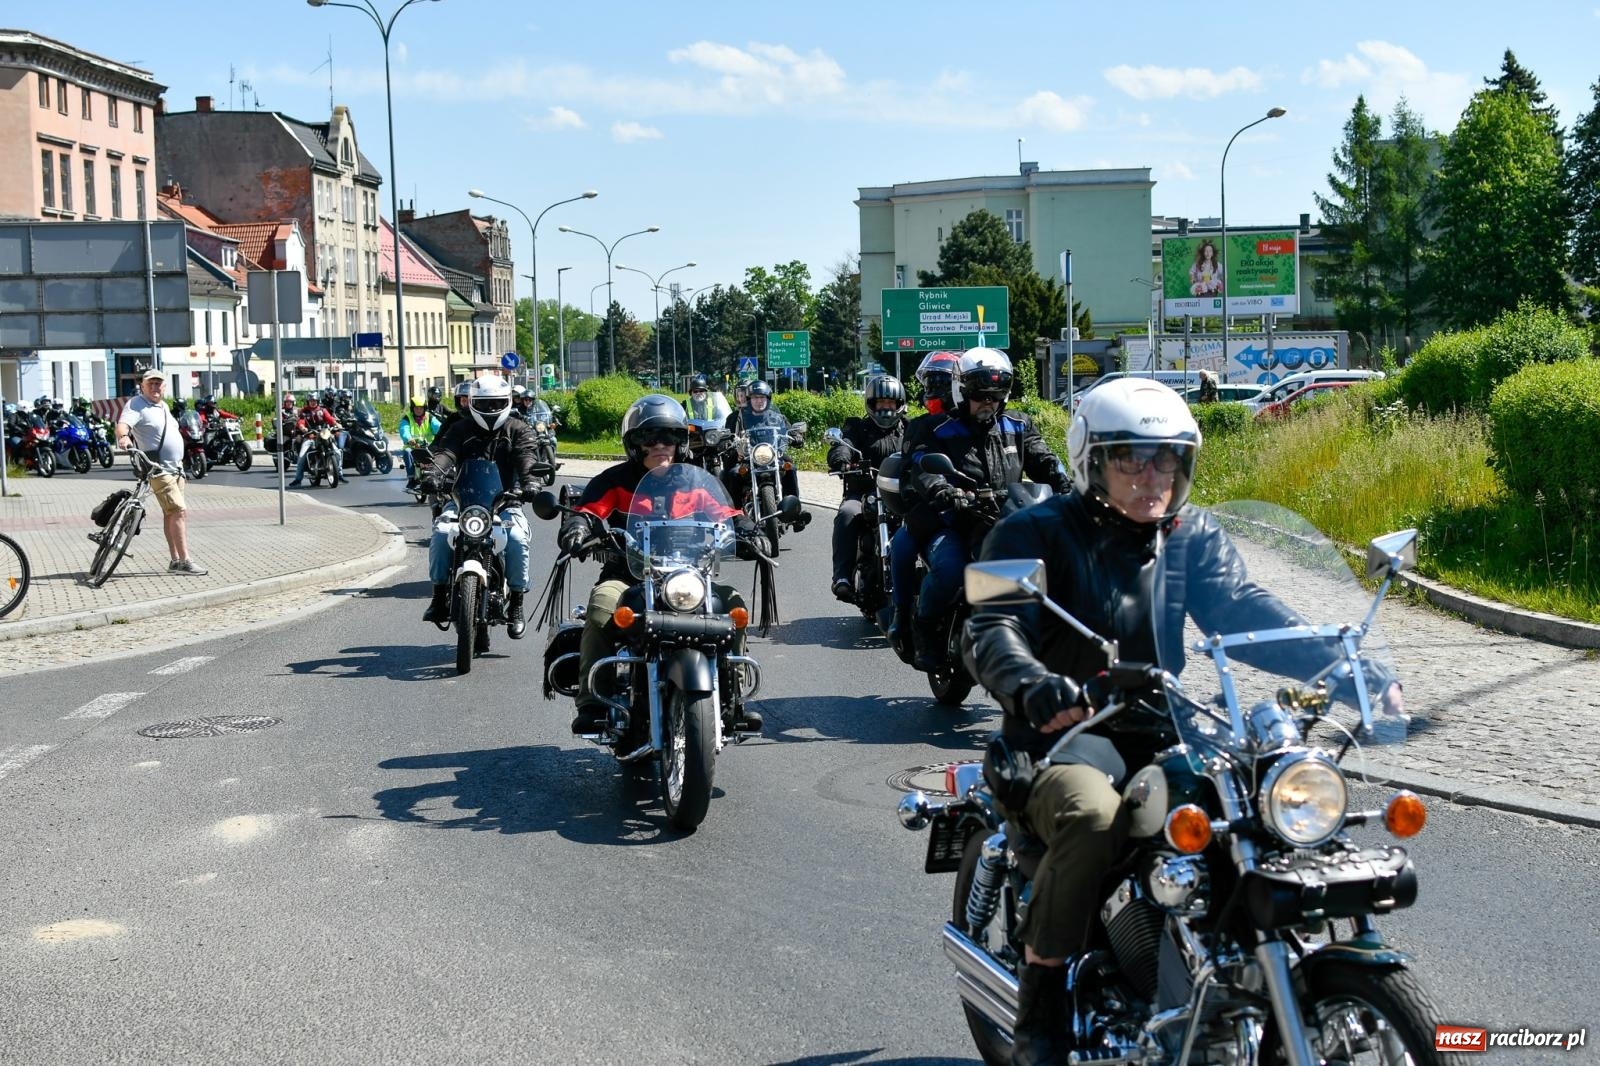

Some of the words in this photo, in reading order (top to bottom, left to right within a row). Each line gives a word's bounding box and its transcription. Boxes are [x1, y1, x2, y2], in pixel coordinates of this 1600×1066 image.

[1241, 259, 1254, 267] EKO
[919, 291, 948, 300] Rybnik
[918, 302, 951, 310] Gliwice
[944, 313, 969, 321] Miejski
[919, 338, 946, 348] Opole
[1178, 341, 1222, 356] POXIMA
